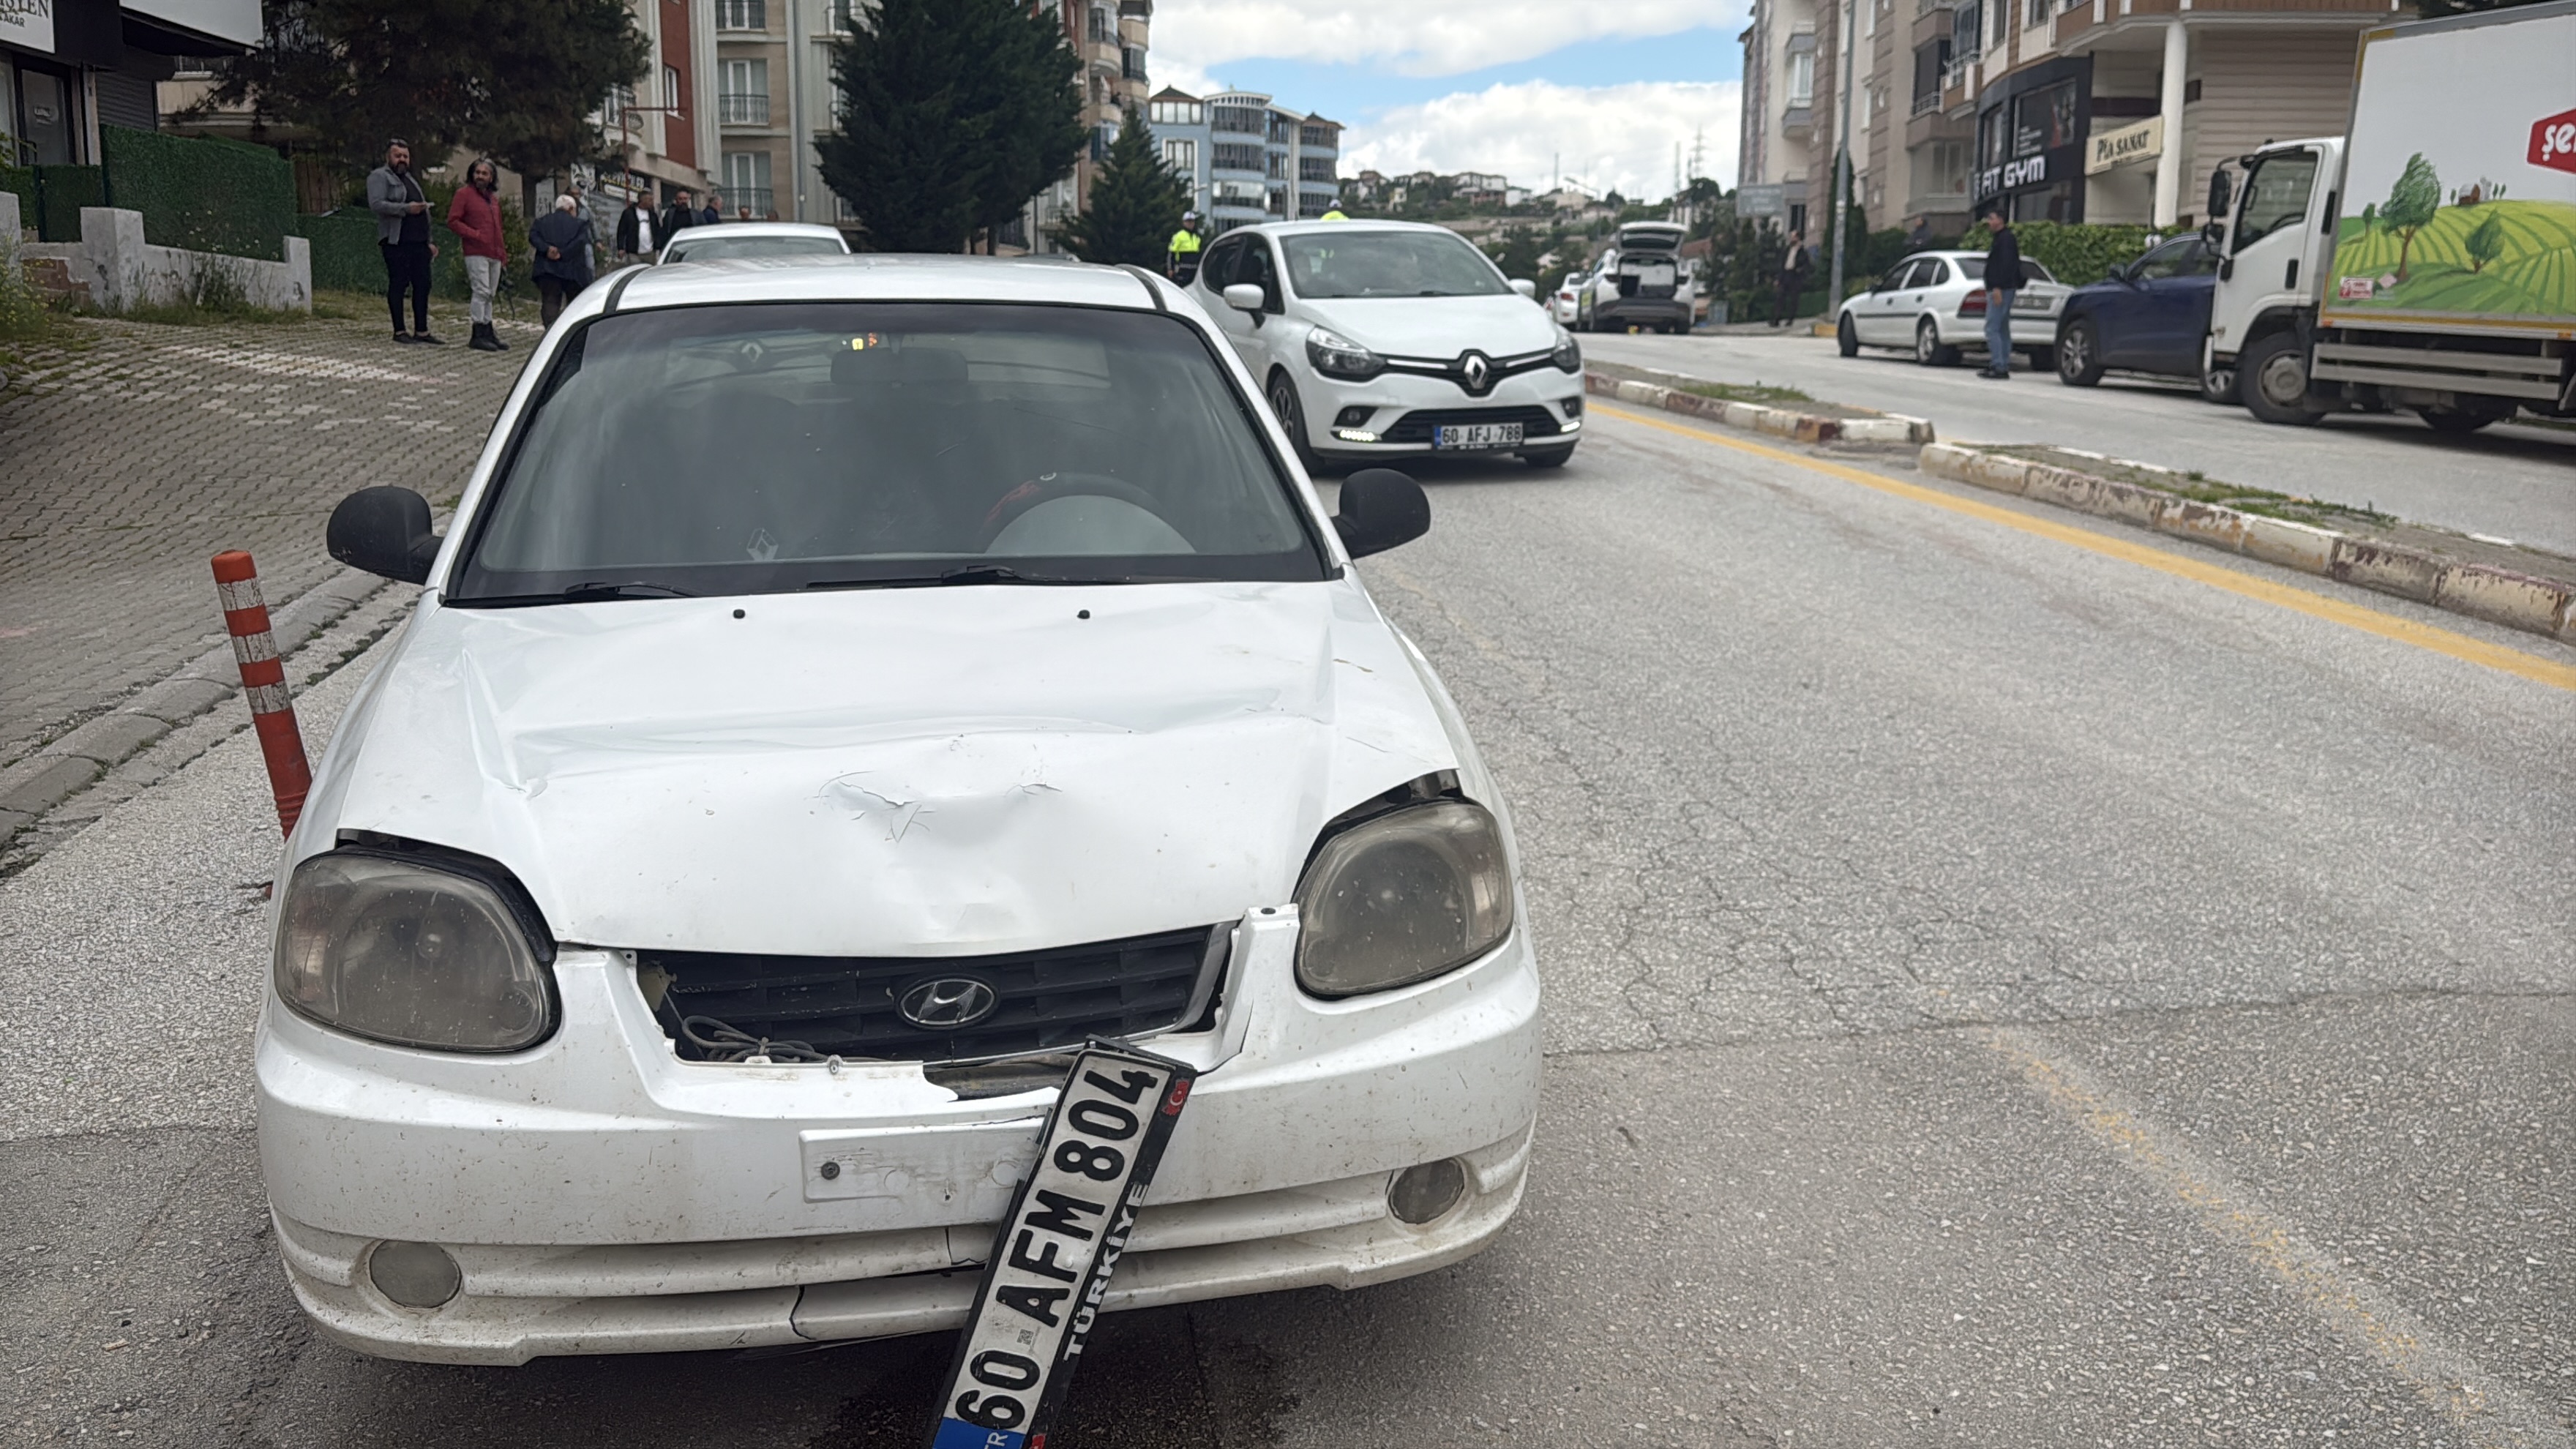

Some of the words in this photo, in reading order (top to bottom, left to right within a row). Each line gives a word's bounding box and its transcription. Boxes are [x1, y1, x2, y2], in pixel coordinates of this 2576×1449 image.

[2004, 154, 2045, 188] GYM
[2542, 121, 2576, 162] şe
[1442, 428, 1459, 443] 60
[1467, 427, 1491, 443] AFJ
[1054, 1069, 1158, 1182] 804
[996, 1189, 1106, 1328] AFM
[1063, 1181, 1149, 1361] TÜRKİYE
[955, 1350, 1041, 1429] 60
